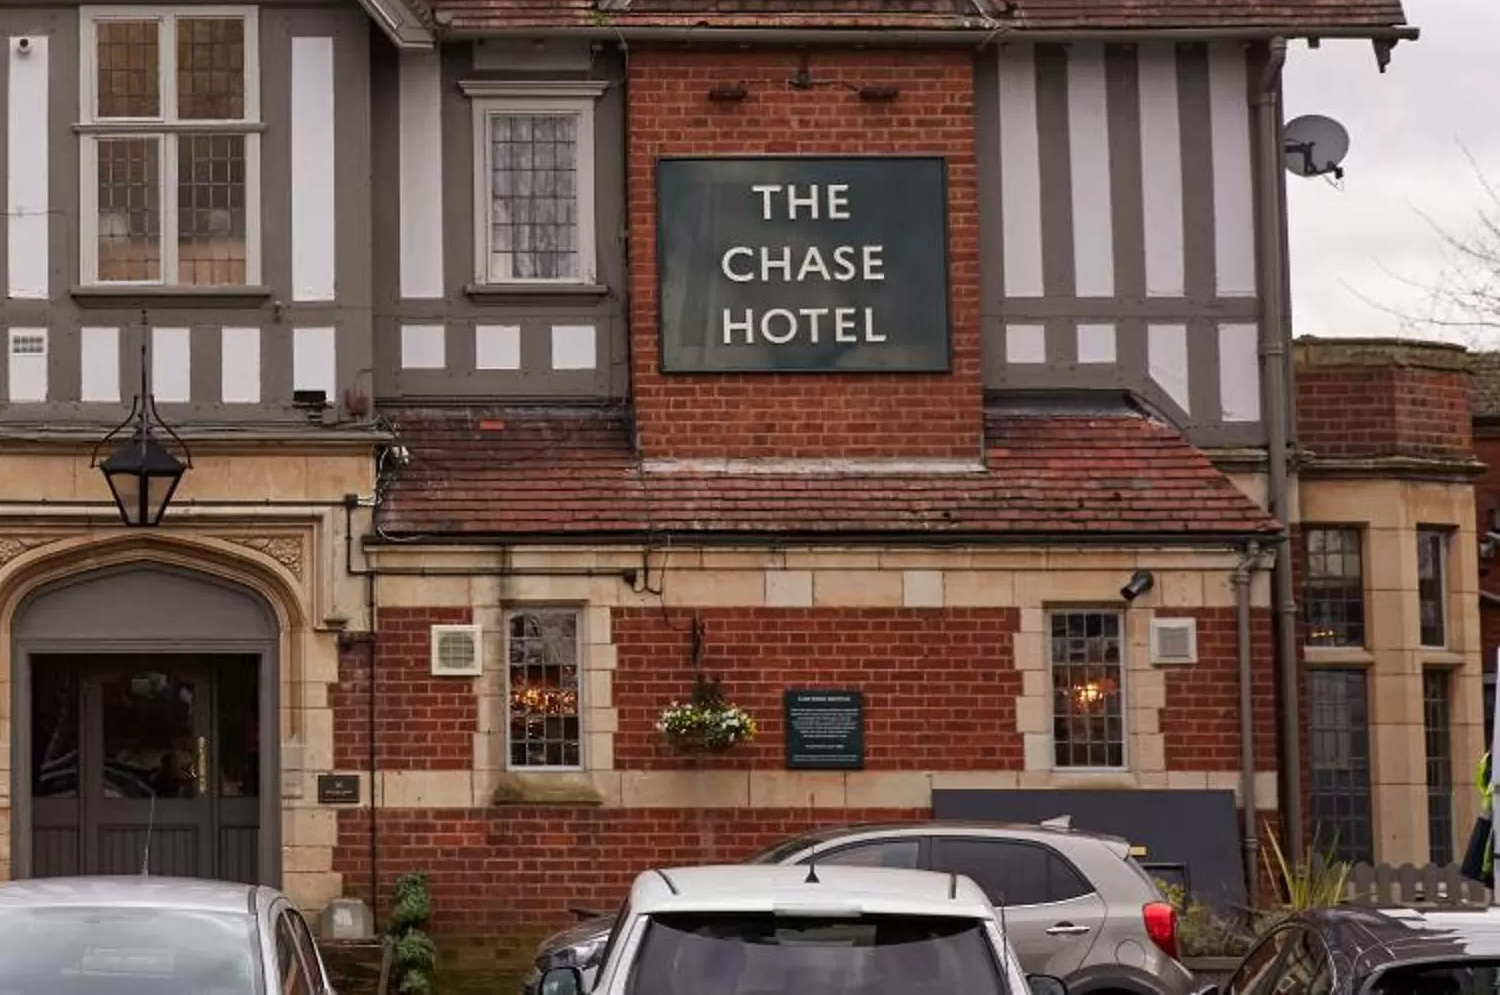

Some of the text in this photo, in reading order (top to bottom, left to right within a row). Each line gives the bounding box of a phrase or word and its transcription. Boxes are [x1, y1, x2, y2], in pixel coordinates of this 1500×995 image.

[752, 184, 851, 220] THE
[722, 245, 885, 282] CHASE
[723, 307, 887, 344] HOTEL
